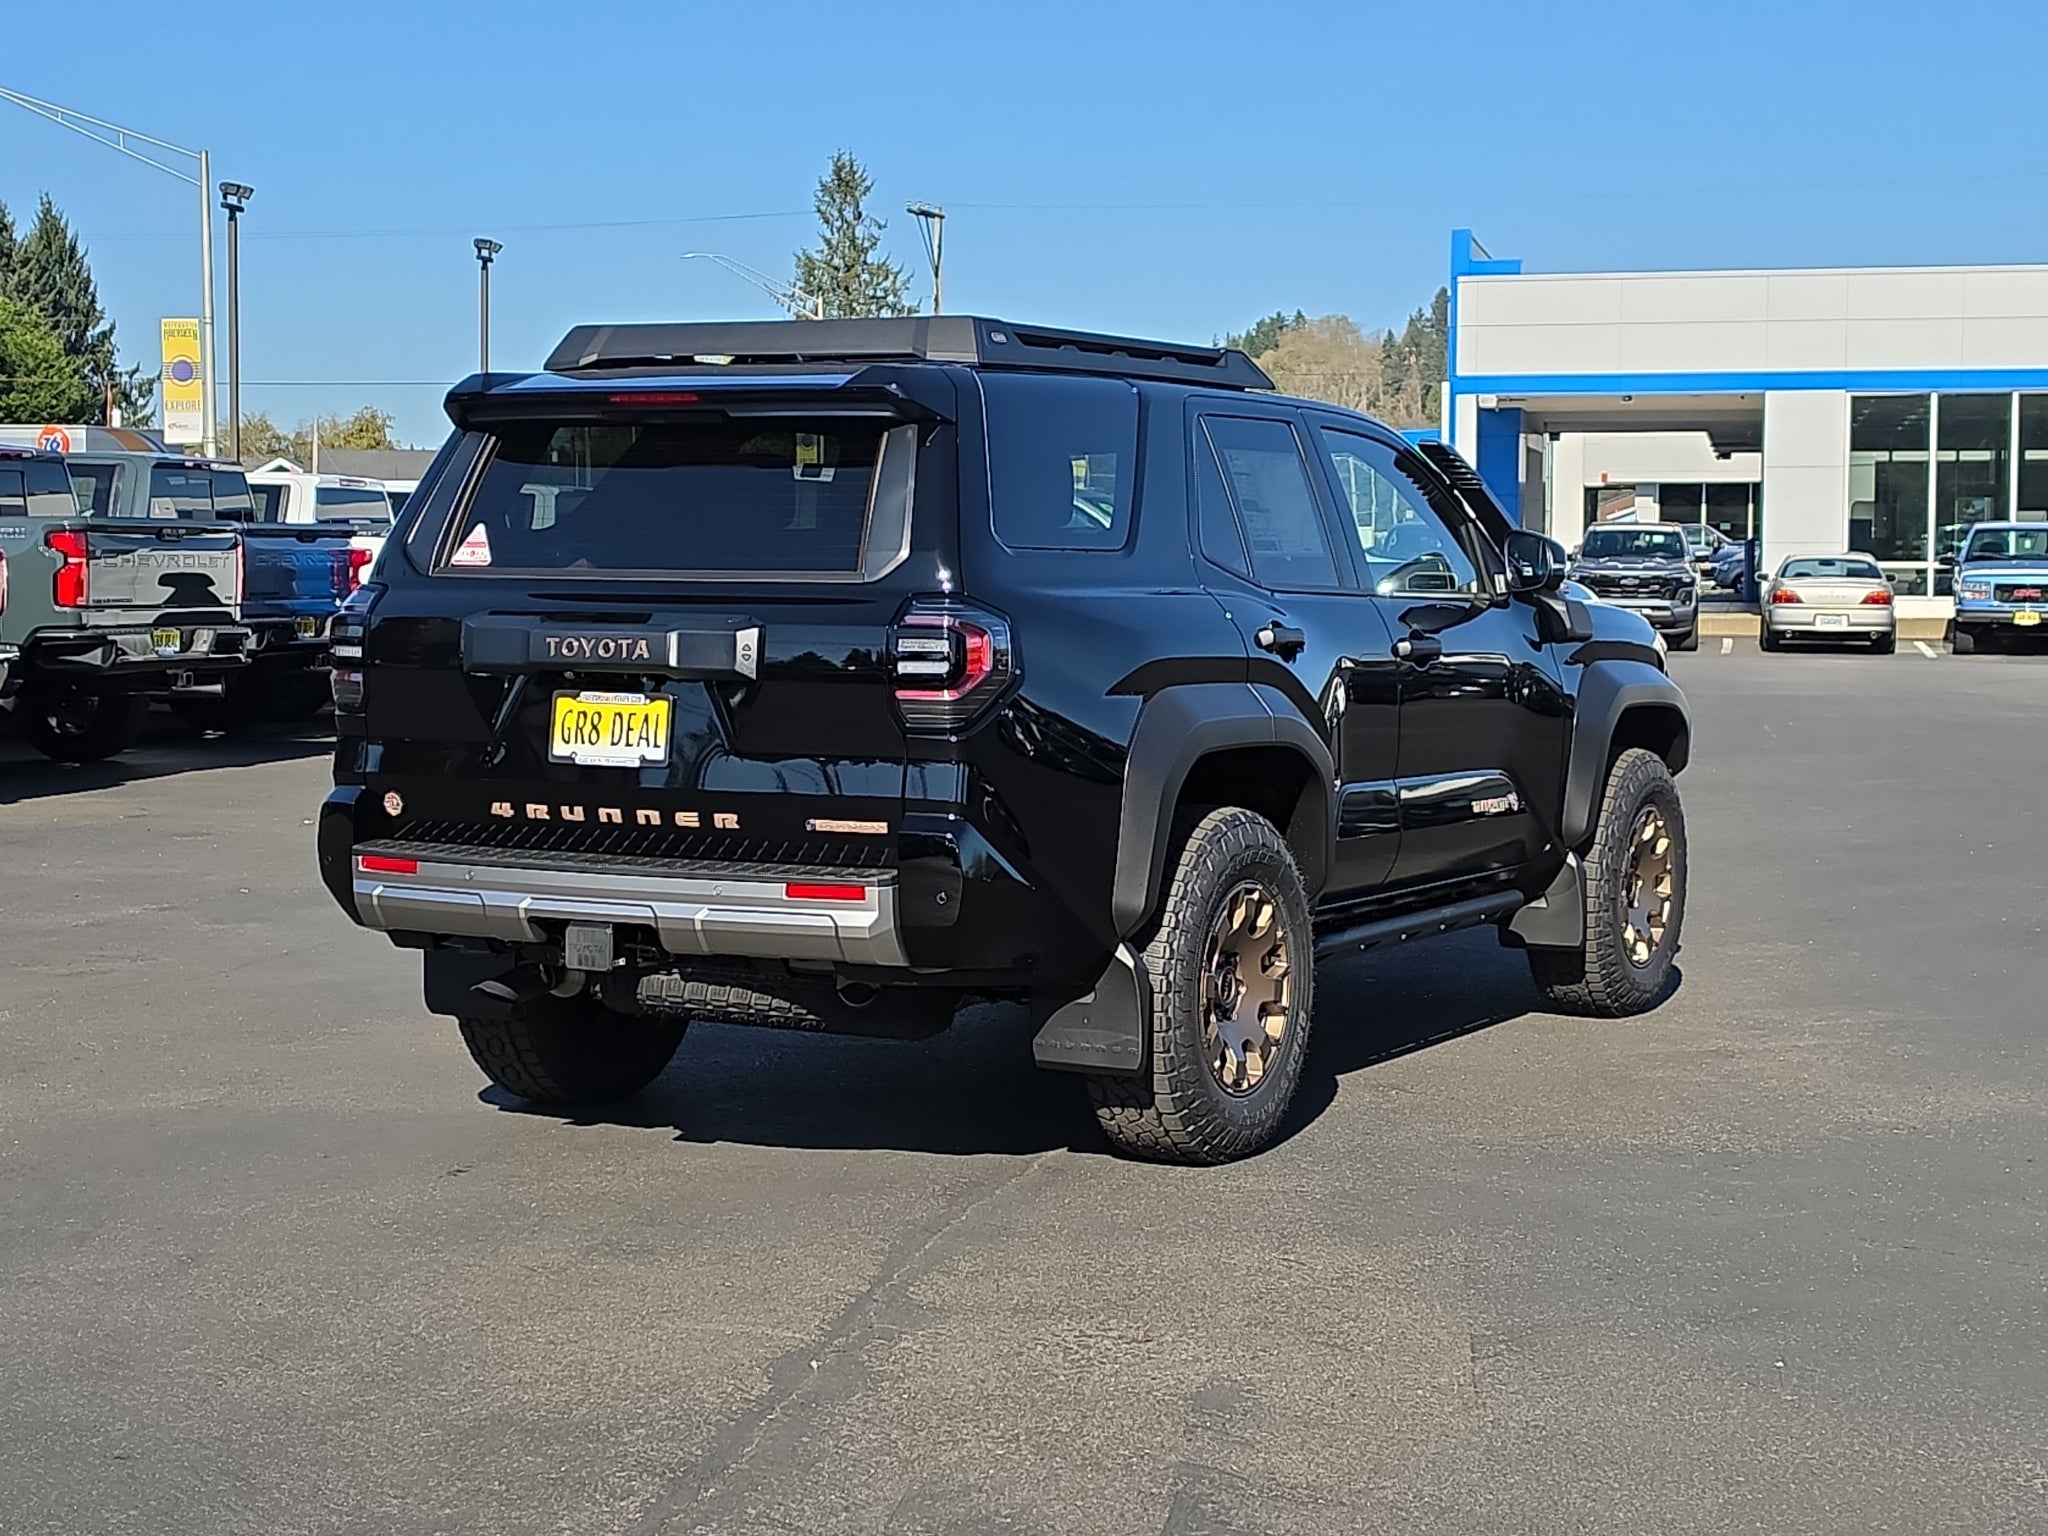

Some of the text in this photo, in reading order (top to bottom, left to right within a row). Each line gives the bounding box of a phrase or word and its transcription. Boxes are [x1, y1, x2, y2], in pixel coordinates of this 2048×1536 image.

[44, 436, 61, 453] 76
[102, 553, 230, 569] CHEVROLET
[546, 637, 650, 660] TOYOTA
[561, 709, 662, 748] GR8 DEAL
[490, 801, 741, 830] 4RUNNER
